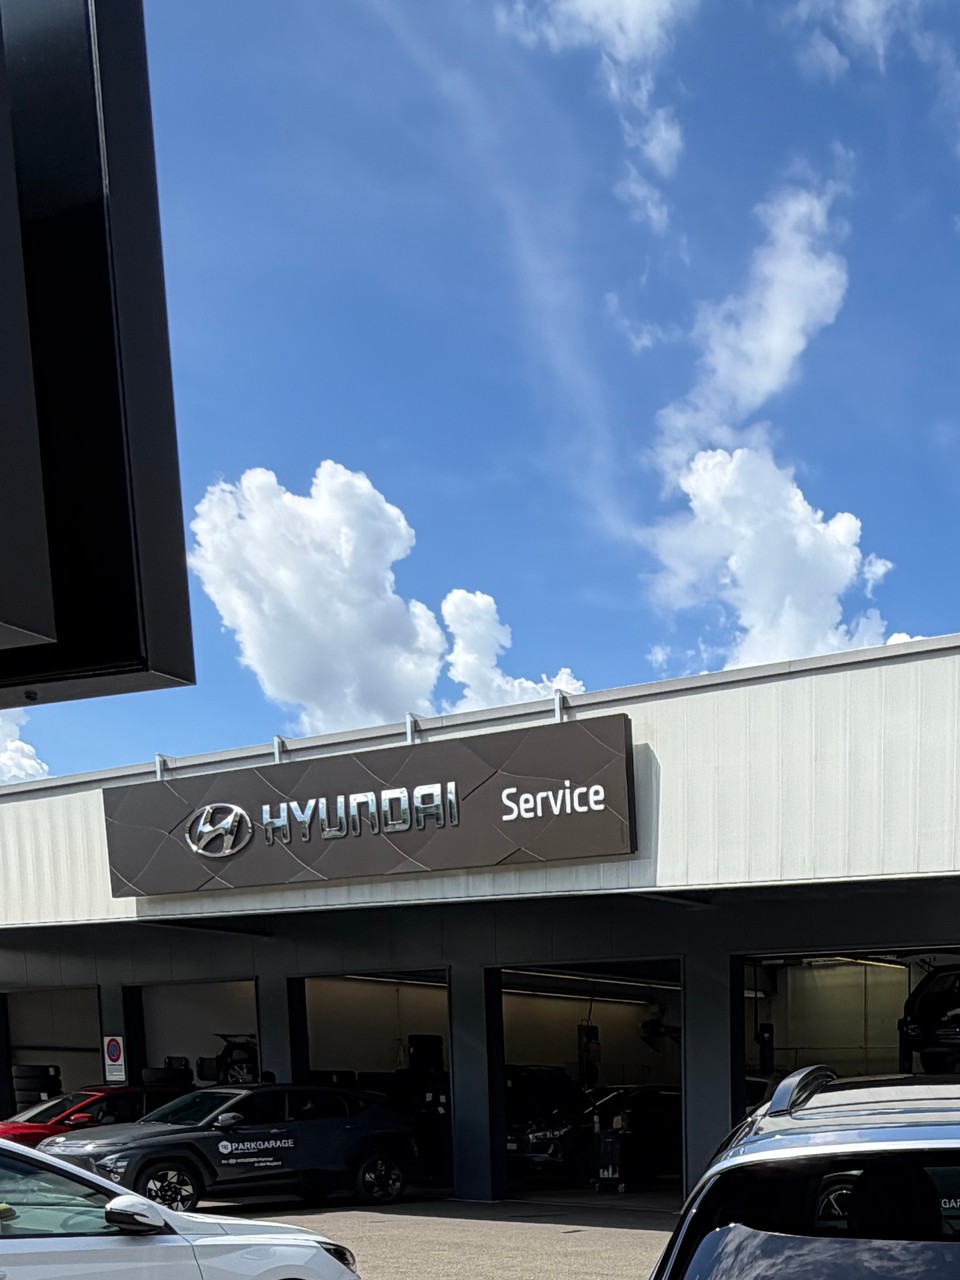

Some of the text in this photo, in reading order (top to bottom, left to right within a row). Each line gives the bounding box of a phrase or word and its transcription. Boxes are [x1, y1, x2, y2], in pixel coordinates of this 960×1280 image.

[262, 780, 605, 845] HYUNDAI Service
[232, 1139, 295, 1151] PARKGARAGE
